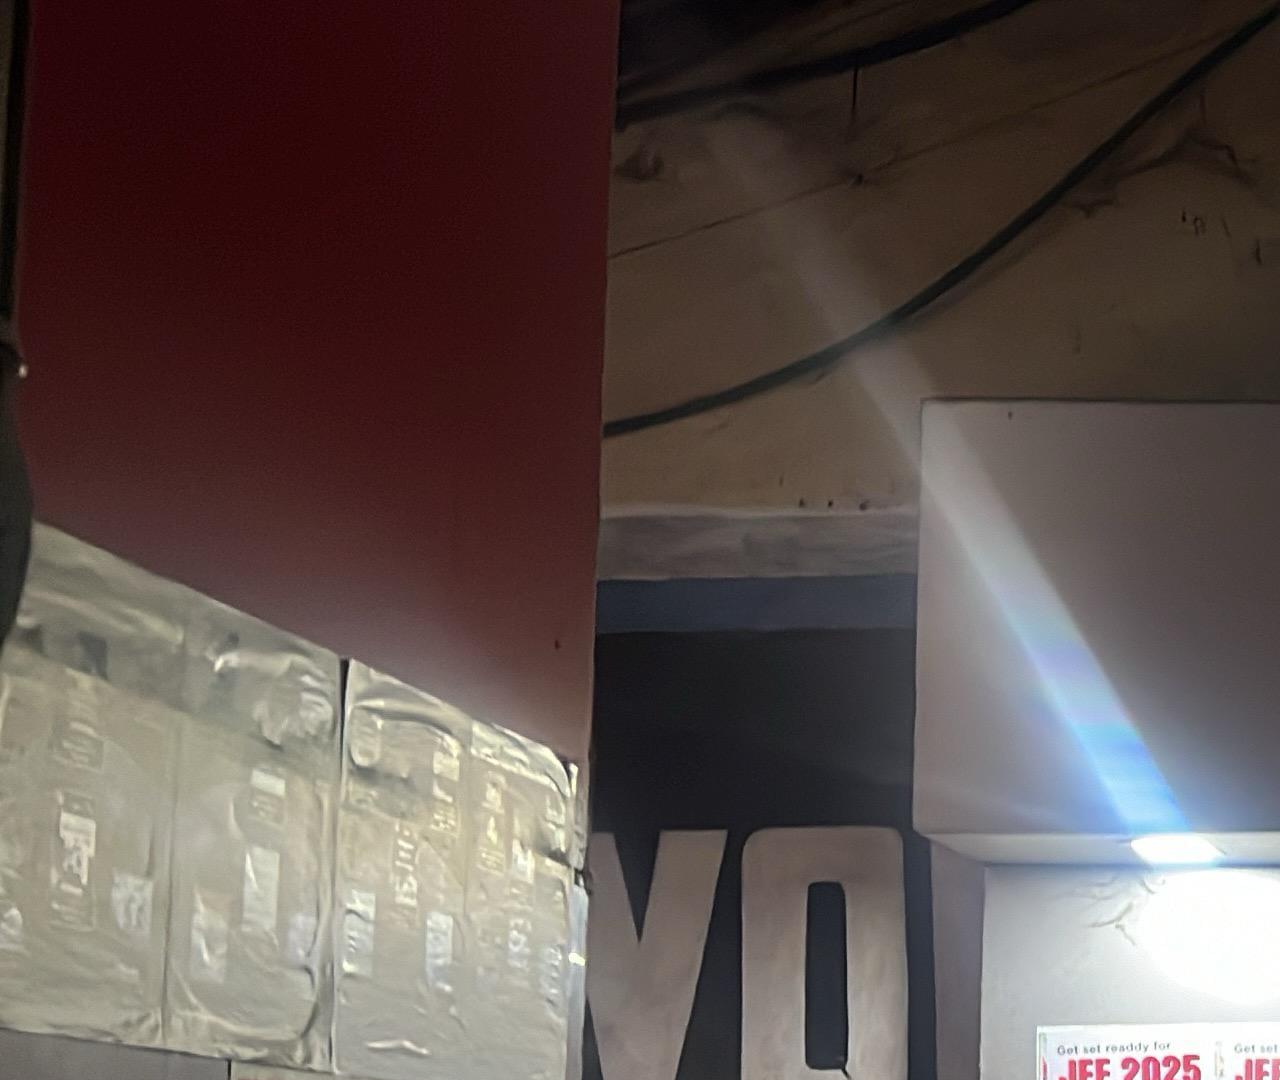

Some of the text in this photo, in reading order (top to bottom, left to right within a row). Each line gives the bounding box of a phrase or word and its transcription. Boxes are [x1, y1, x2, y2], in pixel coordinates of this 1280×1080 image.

[1057, 1045, 1079, 1056] Get
[1084, 1045, 1101, 1055] set
[1154, 1042, 1171, 1050] for
[1234, 1043, 1255, 1054] Get
[1260, 1044, 1277, 1053] set
